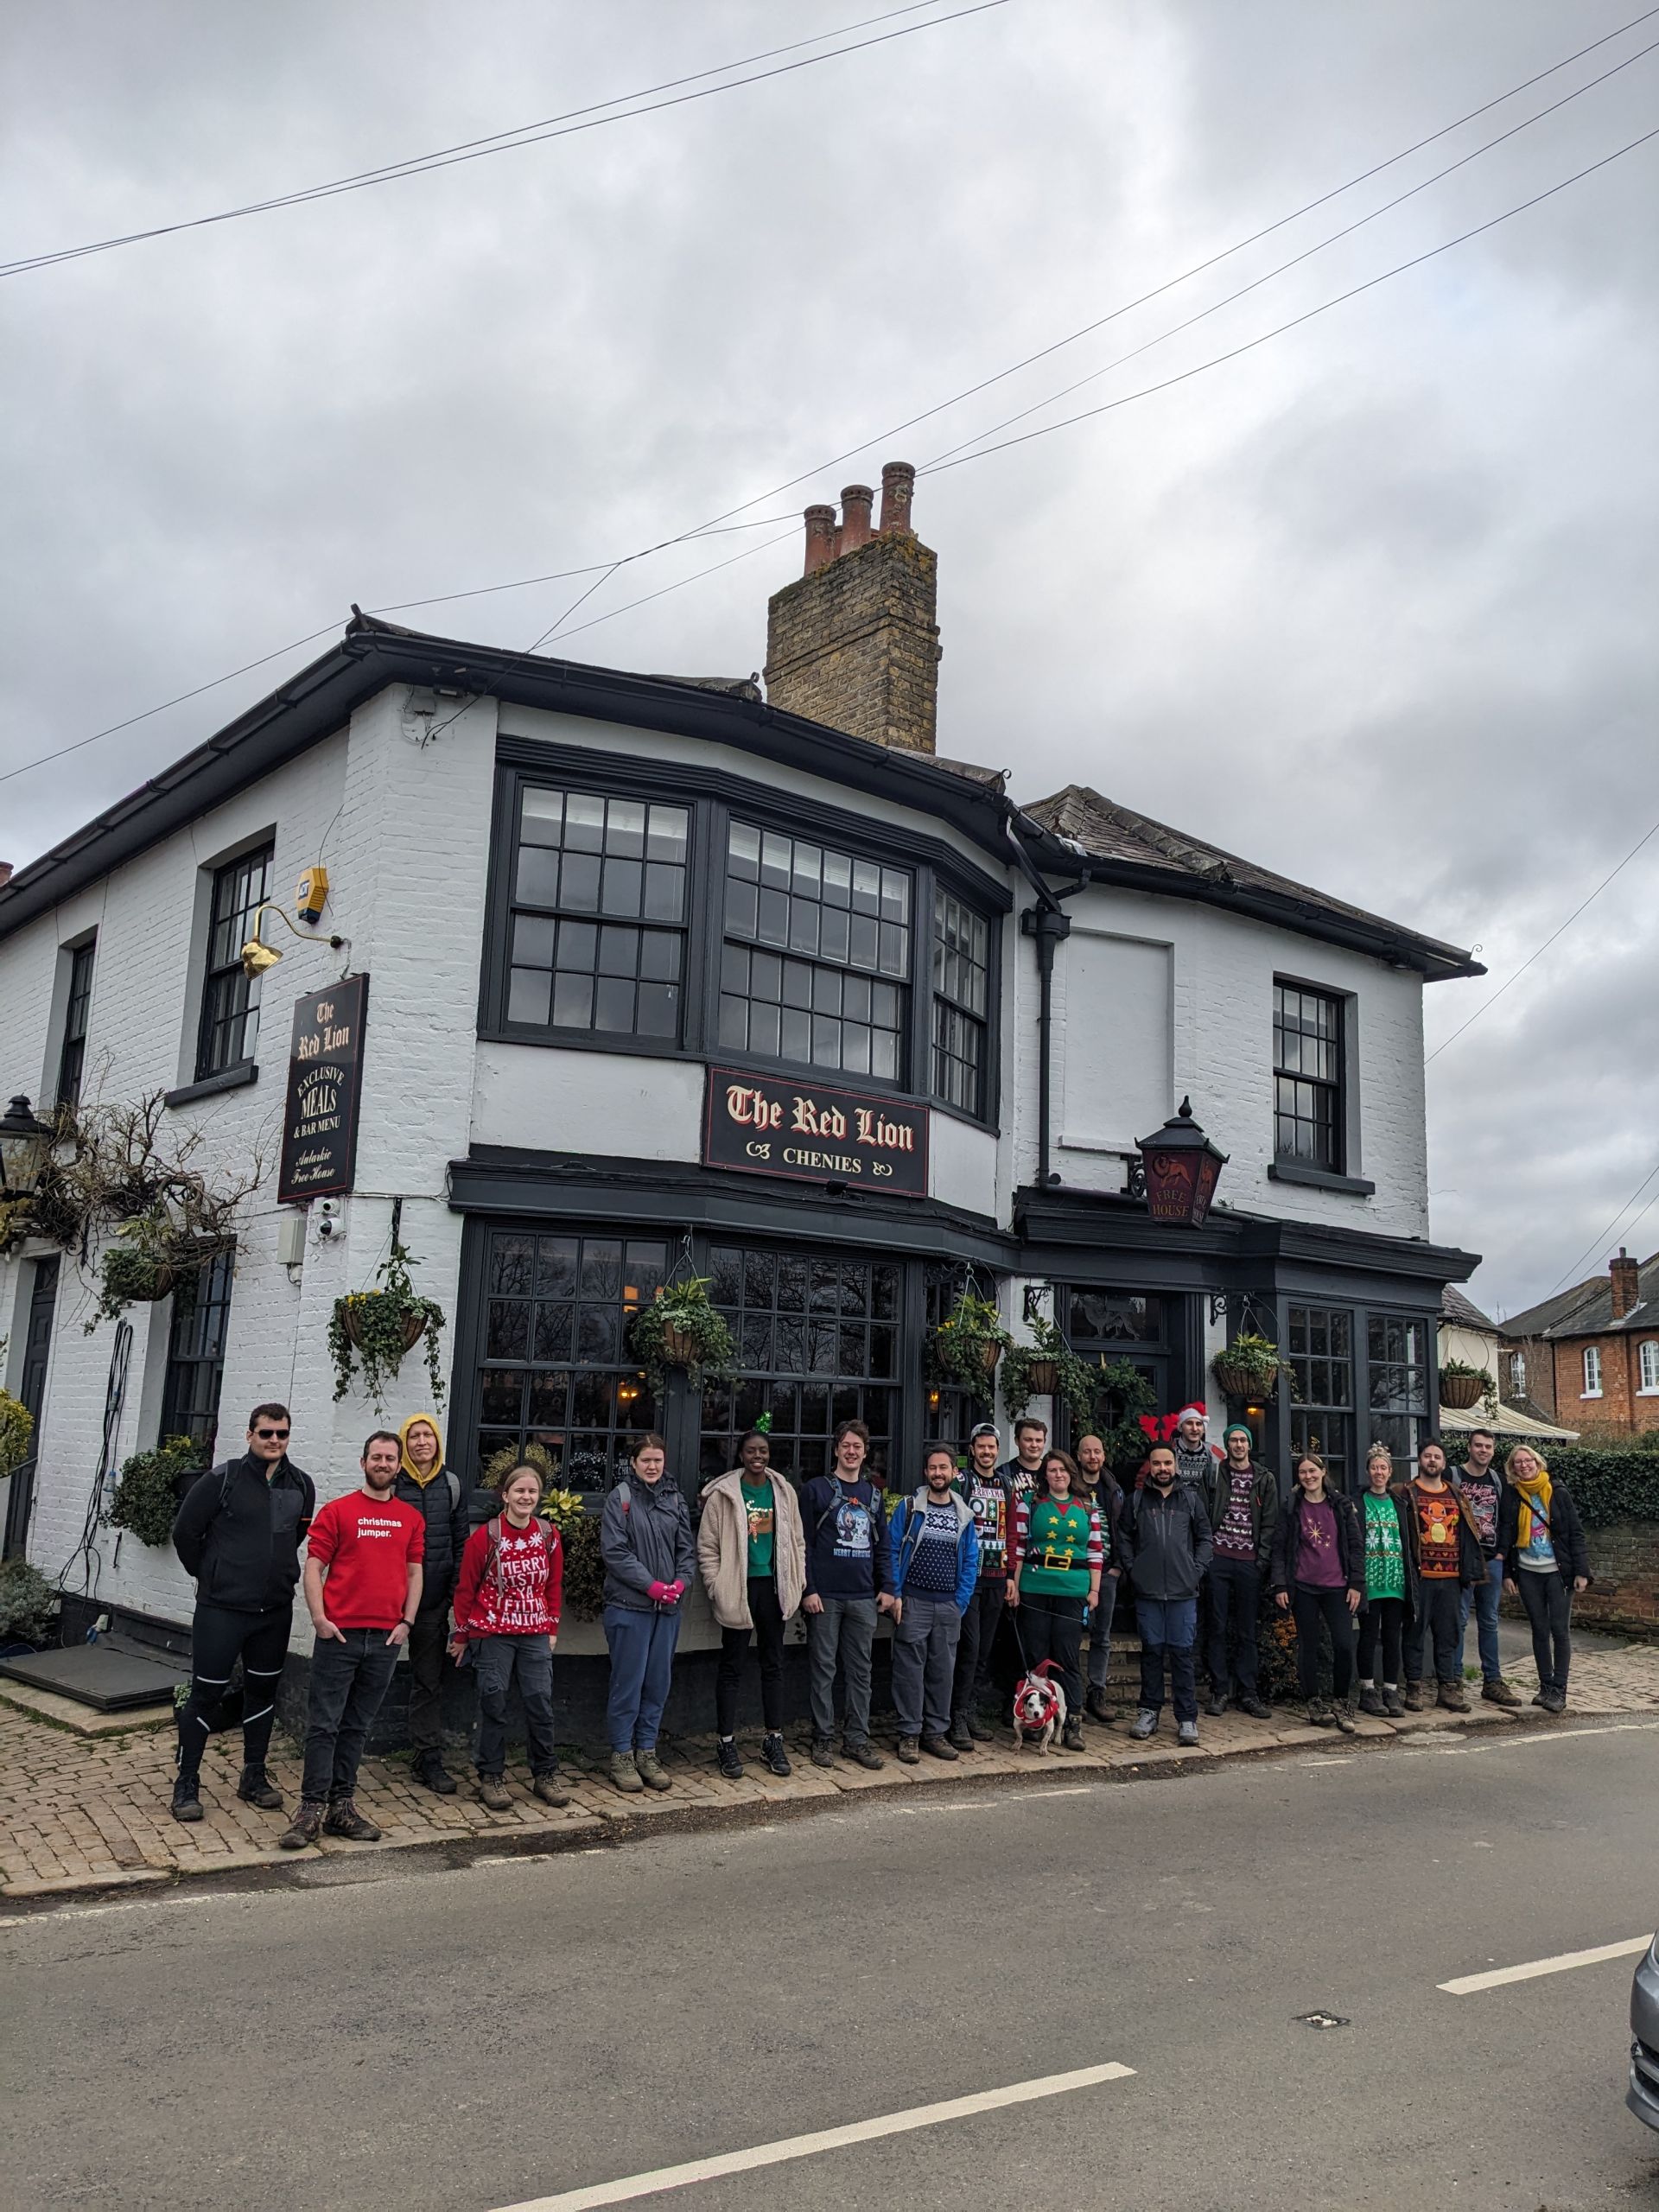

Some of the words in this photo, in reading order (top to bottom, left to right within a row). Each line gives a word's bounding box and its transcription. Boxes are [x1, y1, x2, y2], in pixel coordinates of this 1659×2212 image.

[316, 1001, 334, 1025] The
[297, 1033, 320, 1061] Red
[323, 1025, 350, 1052] Lion
[297, 1065, 345, 1098] EXCLUSIVE
[300, 1084, 337, 1120] MEALS
[293, 1126, 300, 1139] &
[301, 1122, 316, 1137] BAR
[317, 1115, 341, 1133] MENU
[726, 1084, 784, 1130] The
[791, 1096, 849, 1141] Red
[854, 1108, 914, 1152] Lion
[783, 1147, 861, 1173] CHENIES
[290, 1168, 309, 1185] Free
[309, 1164, 336, 1181] House
[1156, 1189, 1185, 1202] FREE
[1153, 1205, 1190, 1217] HOUSE
[357, 1517, 402, 1527] christmas
[357, 1527, 391, 1538] jumper.
[501, 1554, 546, 1576] MERRY
[516, 1586, 534, 1599] YA
[505, 1598, 545, 1613] FILTH
[501, 1611, 548, 1625] ANIMAL
